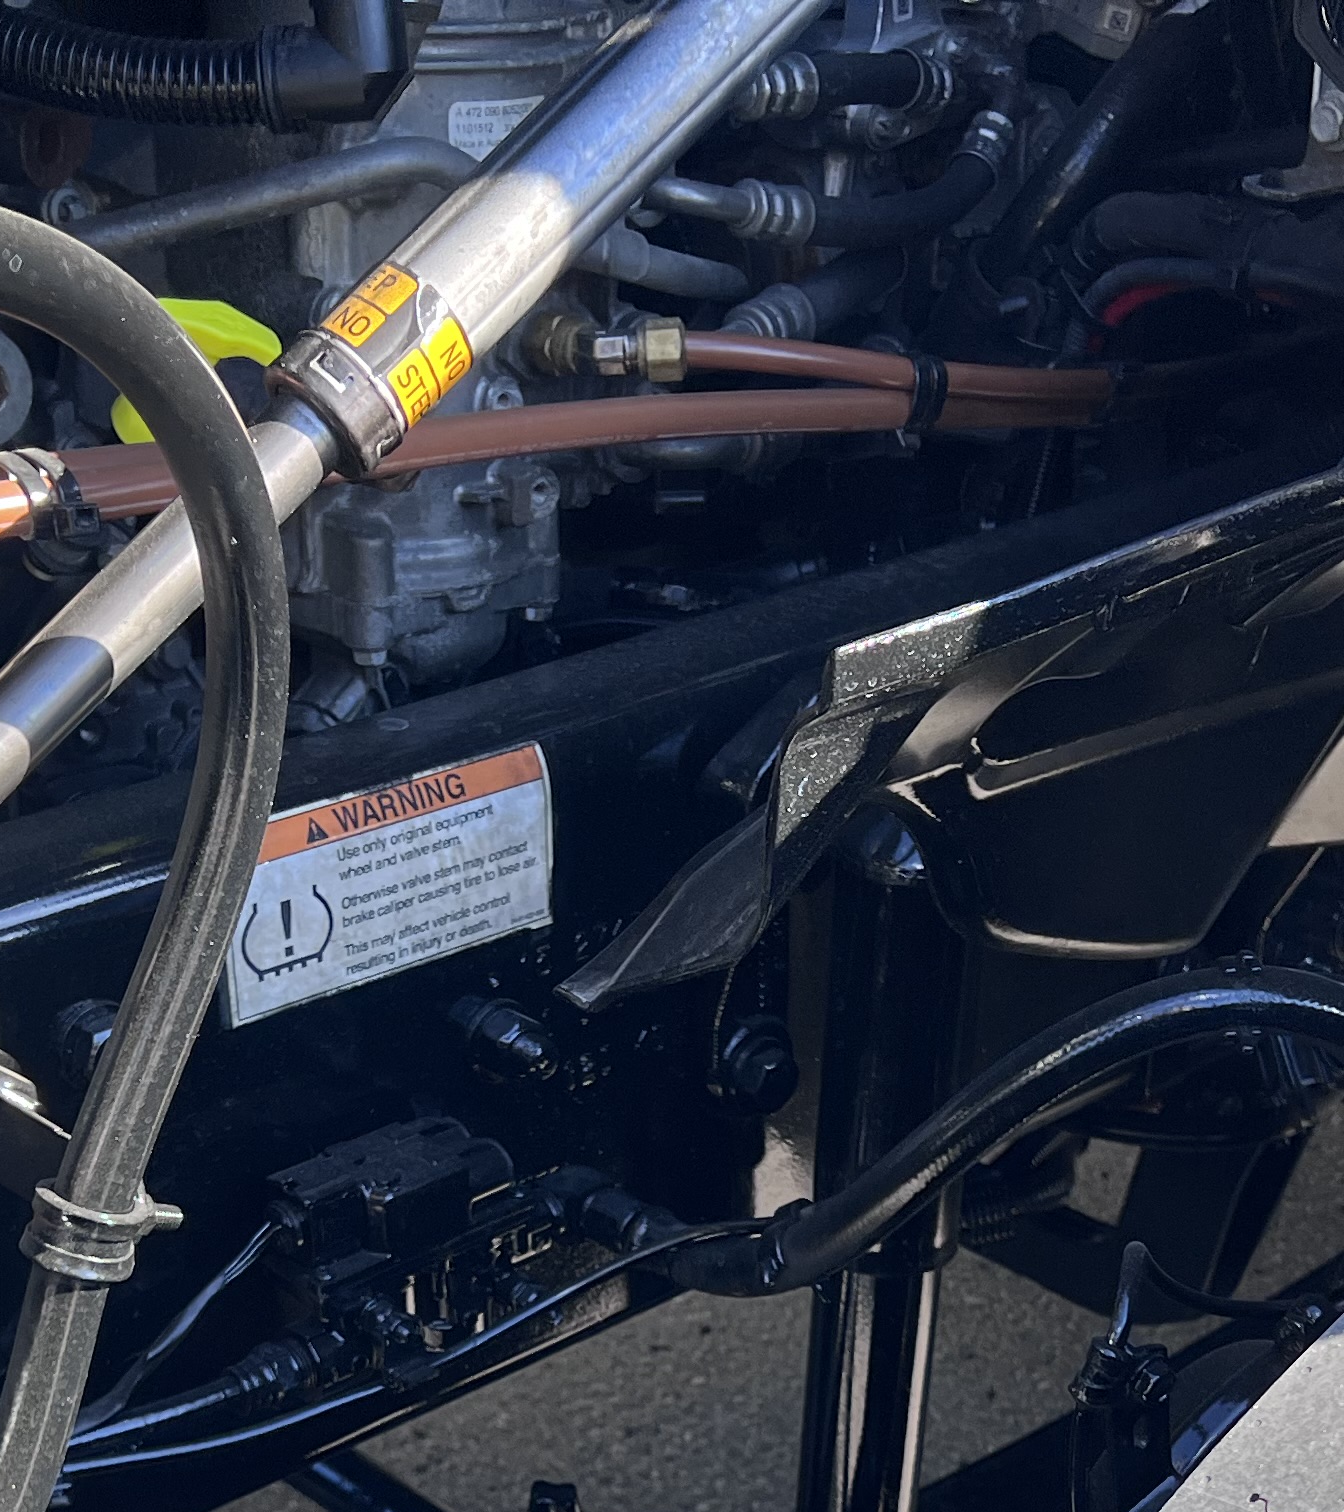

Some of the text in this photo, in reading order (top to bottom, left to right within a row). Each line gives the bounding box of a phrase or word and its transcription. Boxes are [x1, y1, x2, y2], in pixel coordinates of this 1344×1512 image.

[332, 306, 371, 337] NO
[439, 340, 466, 381] NO
[332, 773, 466, 833] WARNING
[336, 803, 494, 862] Use only original equipment
[338, 859, 373, 881] wheel
[375, 852, 397, 871] and
[399, 844, 430, 862] valve
[341, 840, 529, 910] Otherwise valve stem may contact
[342, 908, 375, 929] brake
[376, 895, 416, 917] caliper
[417, 880, 462, 905] causing
[463, 873, 482, 889] tire
[484, 870, 497, 882] to
[497, 862, 521, 878] lose
[344, 891, 512, 957] This may affect vehicle control
[346, 950, 397, 976] resulting
[398, 945, 410, 959] in
[411, 935, 444, 955] injury
[444, 930, 458, 943] or
